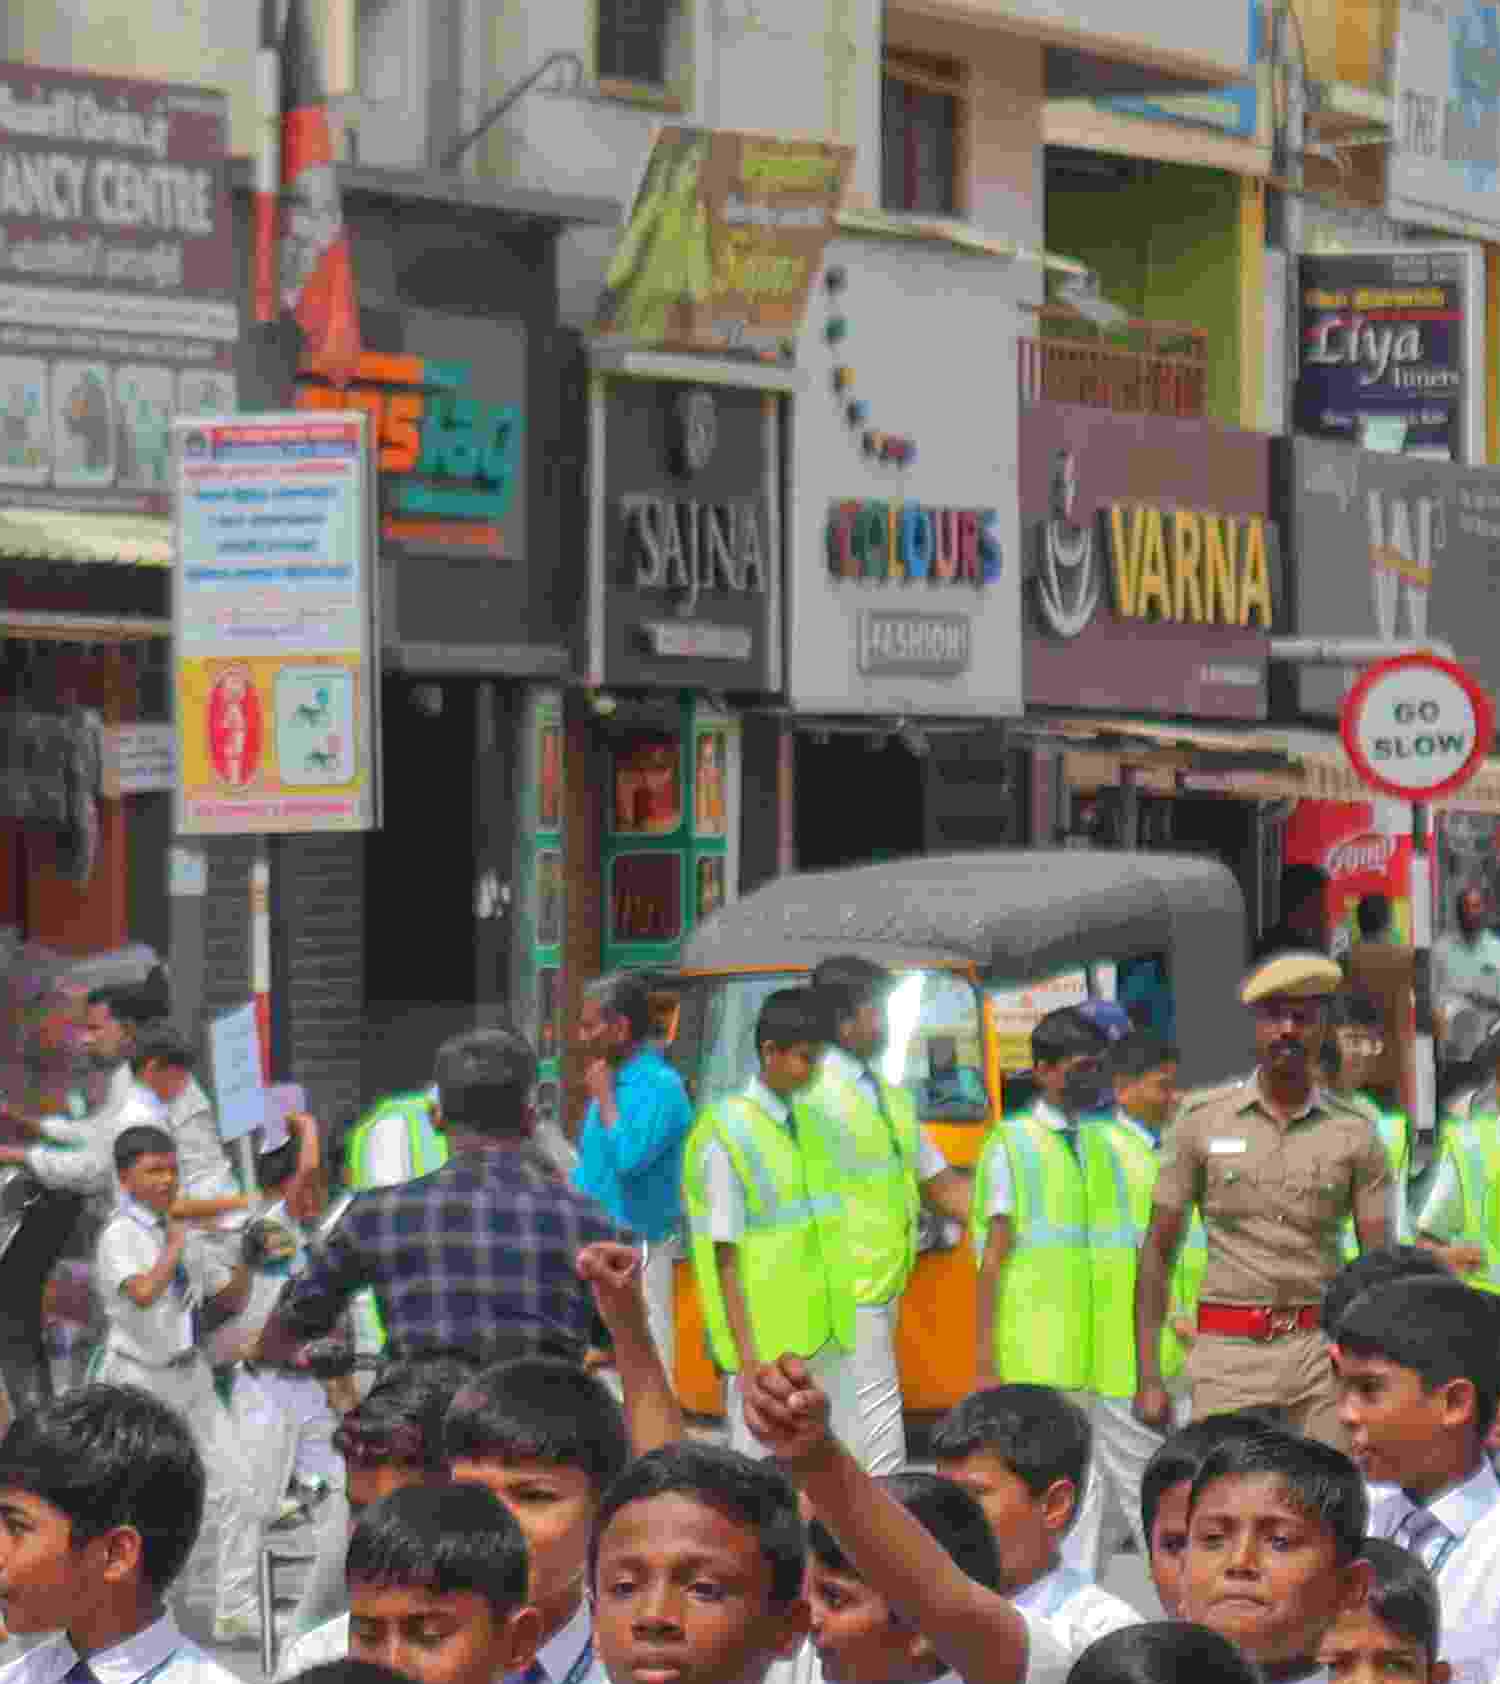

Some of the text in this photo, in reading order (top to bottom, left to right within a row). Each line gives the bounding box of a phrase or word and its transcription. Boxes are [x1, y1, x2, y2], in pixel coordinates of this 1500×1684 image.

[95, 159, 212, 233] CENTRE
[1306, 312, 1424, 385] Liya
[830, 497, 1002, 584] COLOURS
[1109, 504, 1272, 627] VARNA
[1373, 735, 1466, 761] SLOW
[1393, 700, 1441, 725] GO
